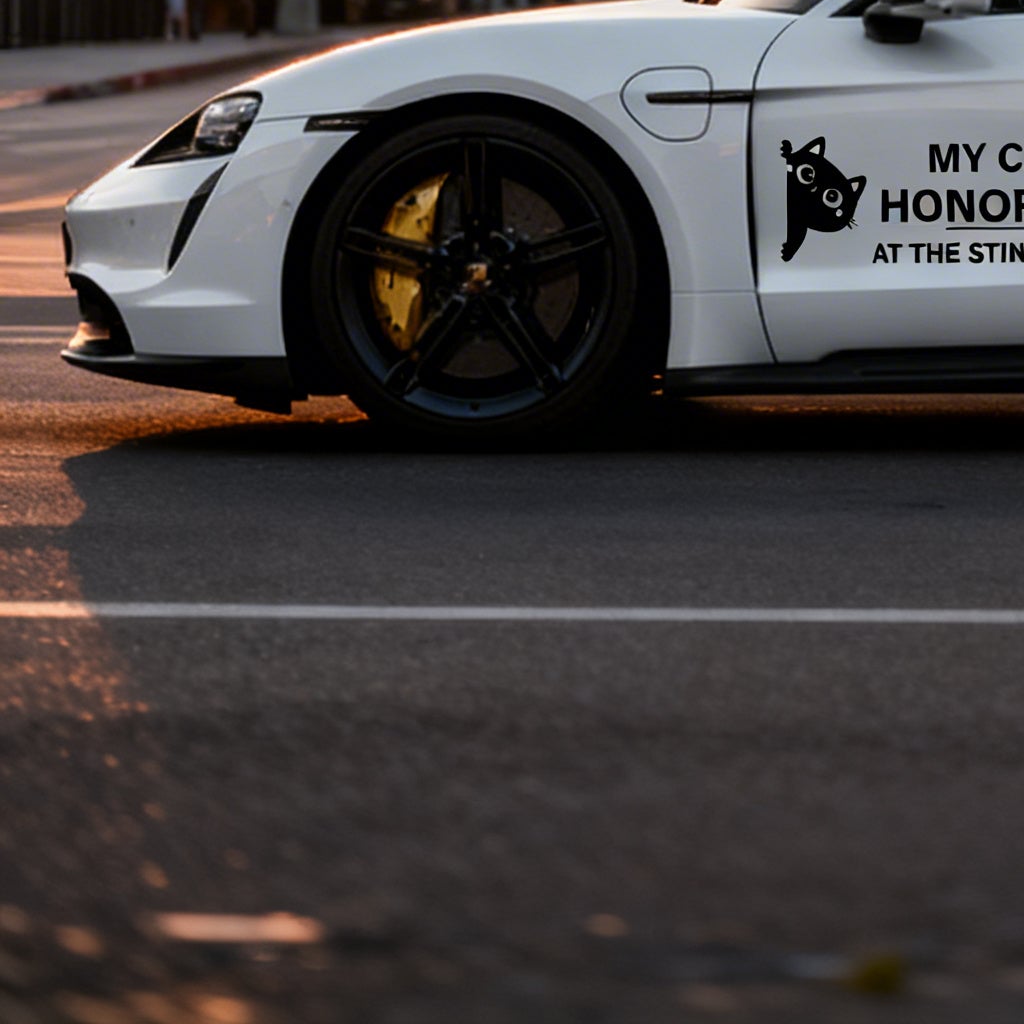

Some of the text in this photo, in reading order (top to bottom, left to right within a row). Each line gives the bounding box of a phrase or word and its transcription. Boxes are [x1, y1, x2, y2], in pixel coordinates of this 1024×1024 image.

[928, 142, 987, 173] MY
[872, 242, 904, 264] AT
[908, 242, 961, 264] THE
